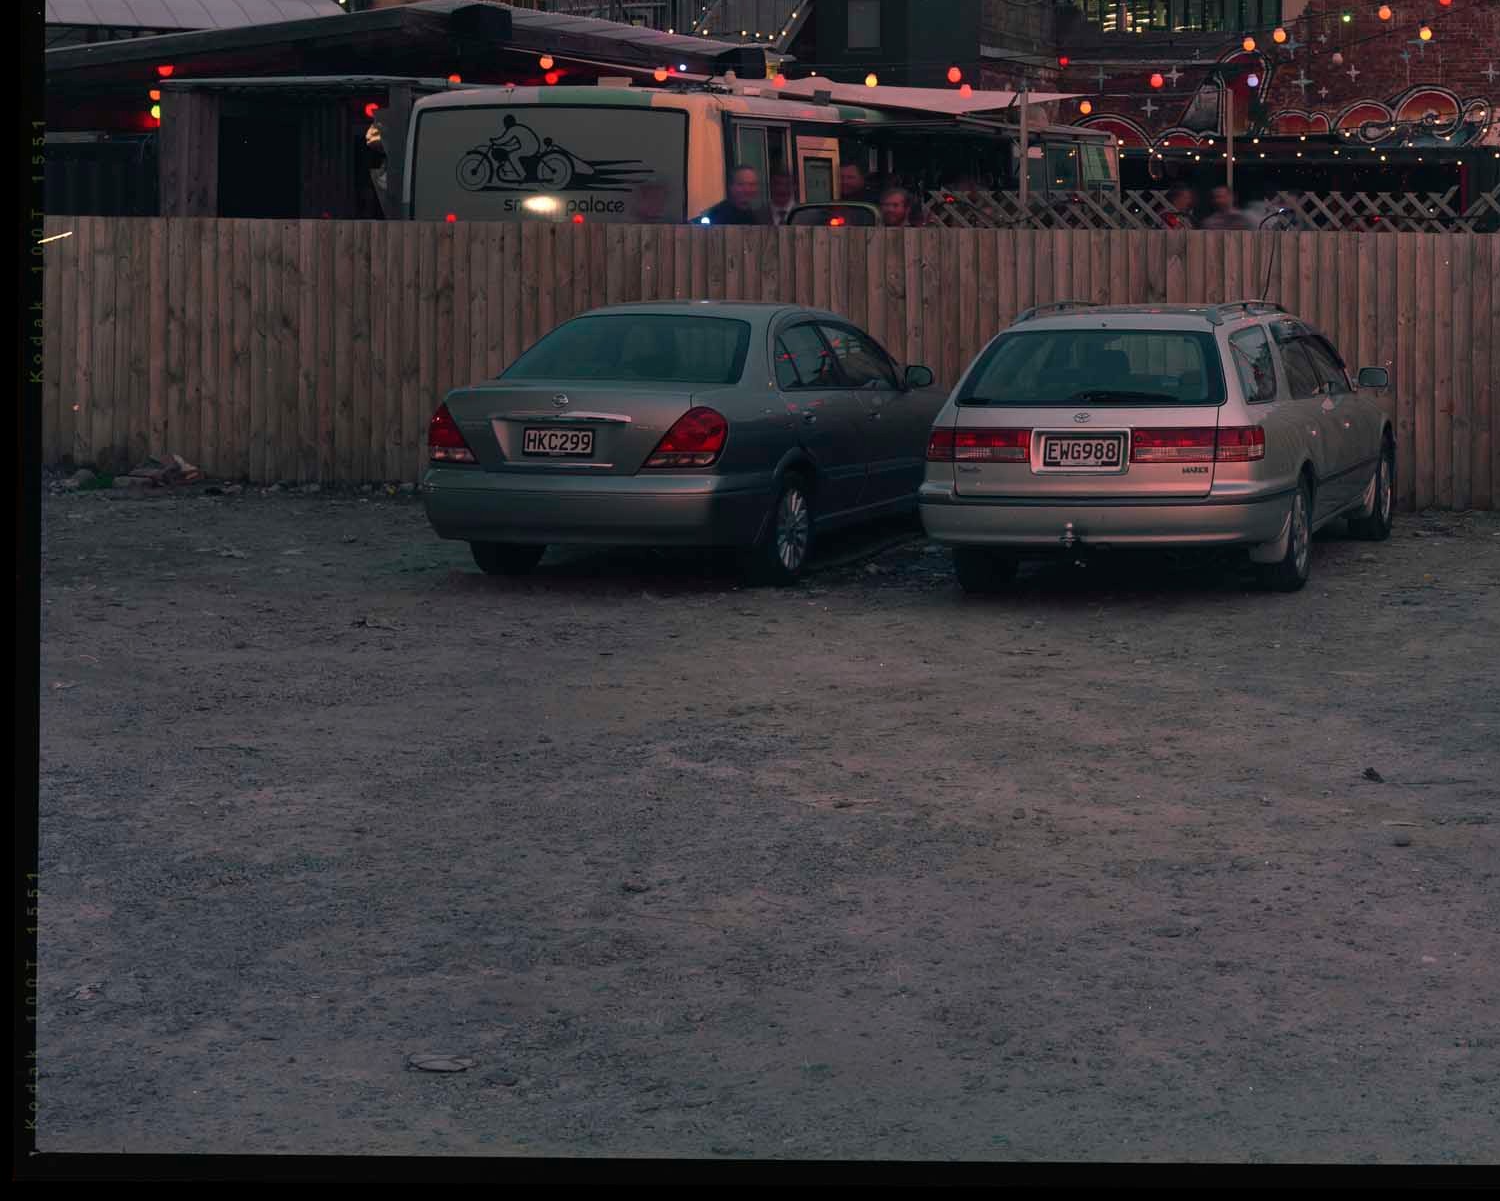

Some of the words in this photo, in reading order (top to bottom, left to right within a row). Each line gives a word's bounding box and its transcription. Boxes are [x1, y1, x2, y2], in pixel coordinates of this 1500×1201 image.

[31, 120, 48, 183] 1551
[566, 194, 625, 216] palace
[527, 432, 591, 451] HKC299
[1047, 442, 1116, 460] EWG988
